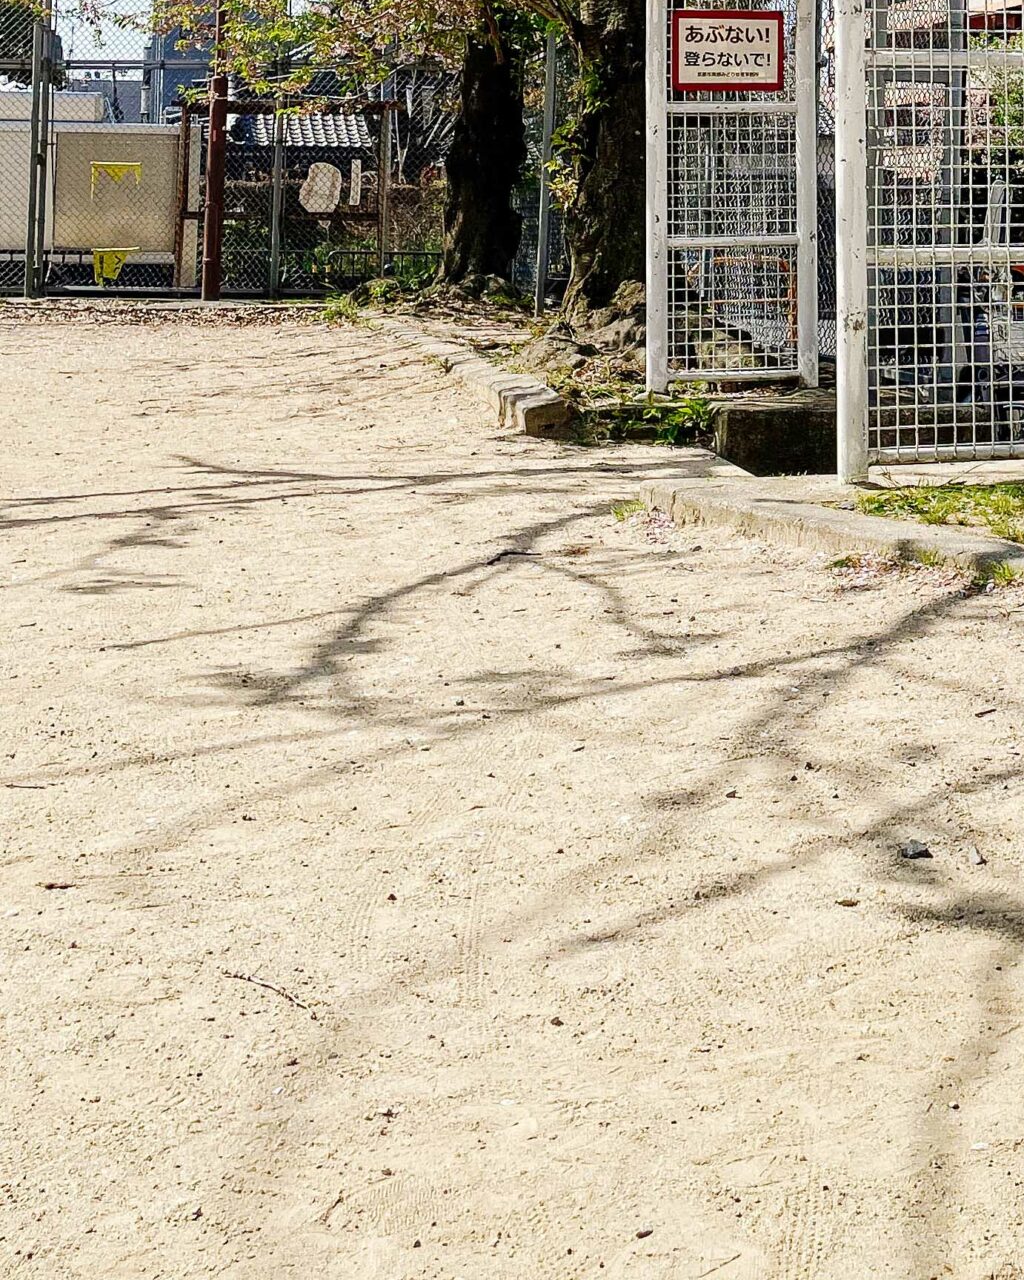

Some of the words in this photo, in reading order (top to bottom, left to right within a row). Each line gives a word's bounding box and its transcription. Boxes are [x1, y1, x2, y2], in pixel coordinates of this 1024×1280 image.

[685, 24, 770, 43] あぶない!
[684, 51, 771, 67] 登らないで!
